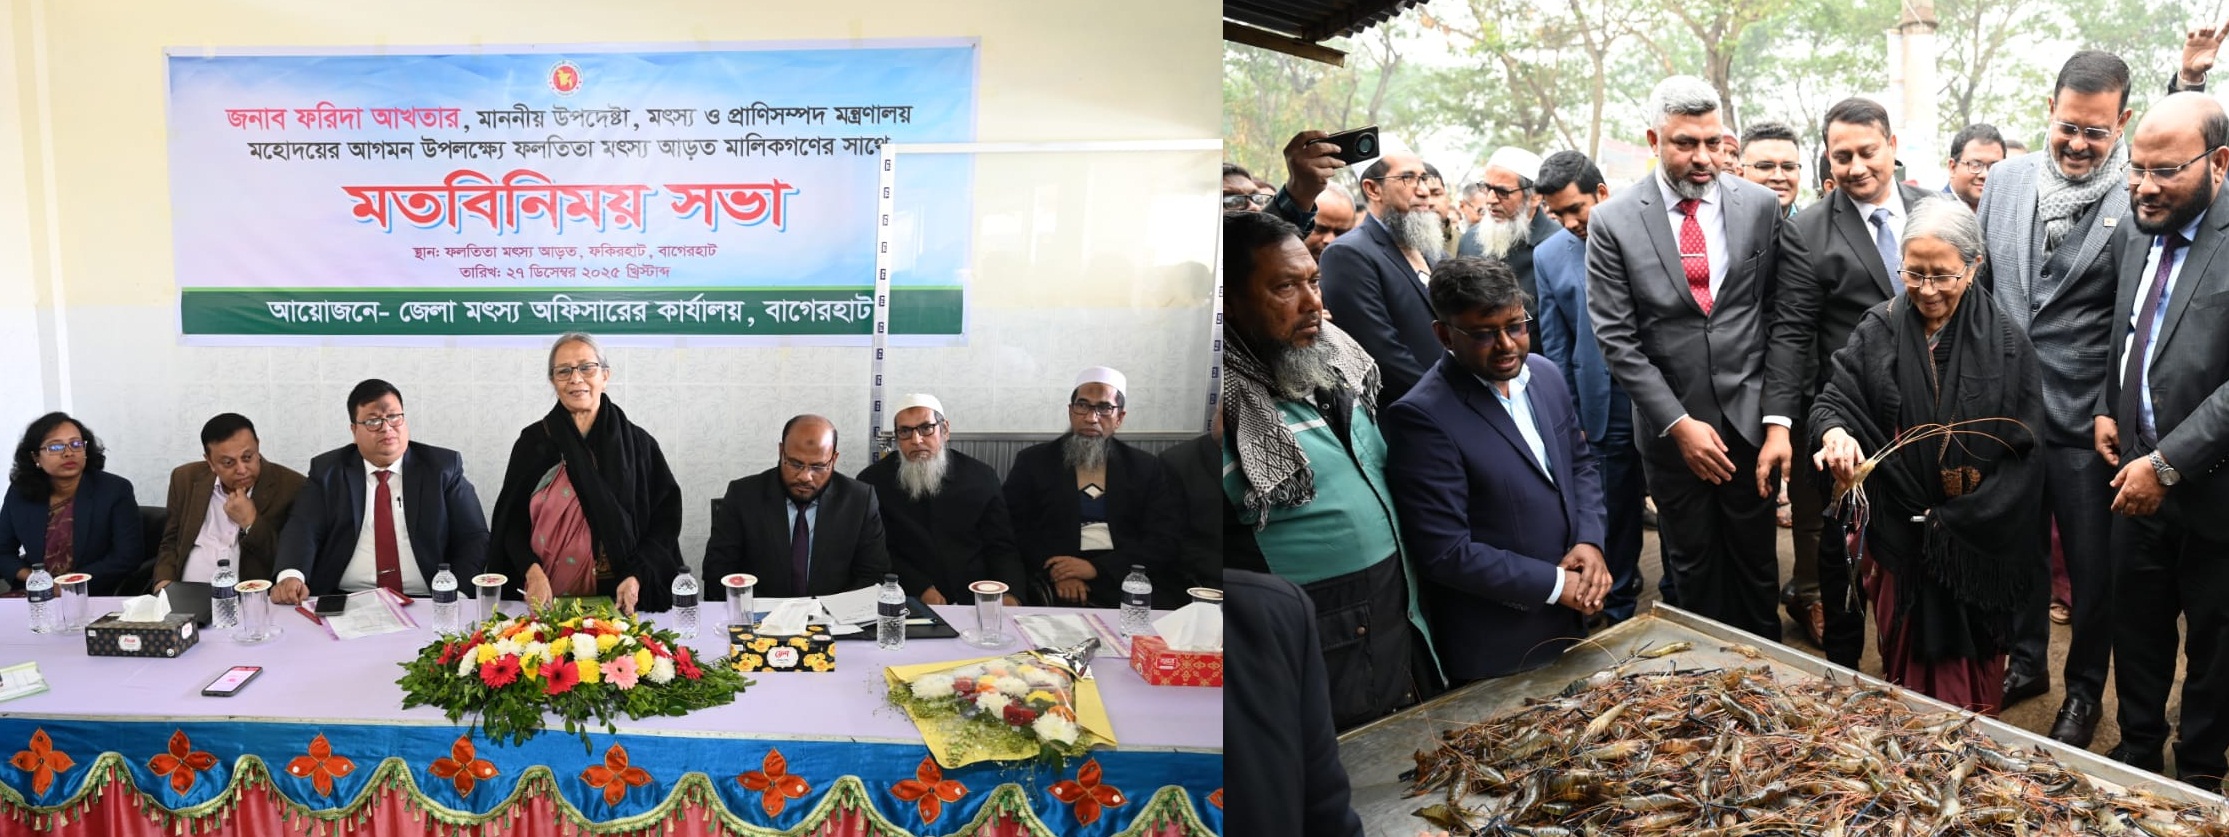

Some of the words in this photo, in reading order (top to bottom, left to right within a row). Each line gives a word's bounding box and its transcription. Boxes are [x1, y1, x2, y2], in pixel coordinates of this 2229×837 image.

[225, 107, 287, 130] জনাব
[294, 101, 363, 130] ফরিদা
[476, 103, 546, 129] মাননীয়
[646, 108, 698, 127] মৎস্য
[704, 108, 720, 125] ও
[728, 101, 828, 127] প্রাণিসম্পদ
[833, 104, 914, 126] মন্ত্রণালয়
[247, 141, 341, 161] মহোদয়ের
[347, 140, 415, 160] আগমন
[512, 134, 595, 159] ফলতিতা
[600, 140, 651, 158] মৎস্য
[656, 138, 718, 161] আড়ত
[723, 132, 836, 157] মালিকগণের
[341, 169, 656, 232] মতবিনিময়
[663, 178, 797, 231] সভা
[444, 243, 498, 259] ফলতিতা
[502, 246, 533, 259] মৎস্য
[657, 243, 717, 258] বাগেরহাট
[459, 264, 501, 279] তারিখ:
[506, 267, 525, 279] ২৭
[529, 264, 577, 279] ডিসেম্বর
[582, 266, 620, 279] ২০২৫
[399, 299, 456, 323] জেলা
[461, 300, 523, 324] মৎস্য
[528, 294, 649, 323] অফিসারের
[763, 294, 875, 323] বাগেরহাট
